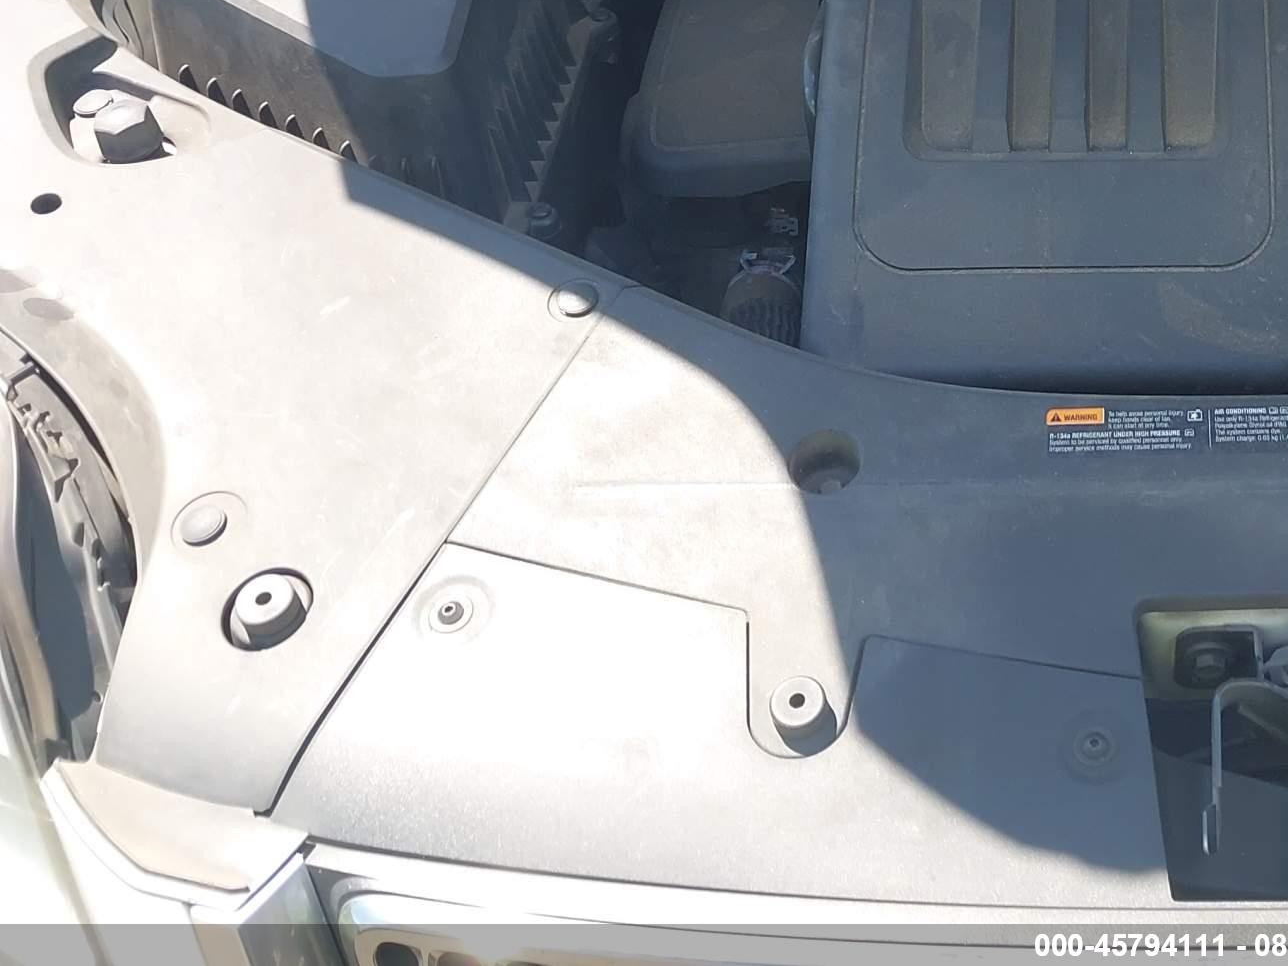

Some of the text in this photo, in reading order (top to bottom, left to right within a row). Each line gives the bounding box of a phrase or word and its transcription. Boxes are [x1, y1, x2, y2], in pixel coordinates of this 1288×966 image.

[1225, 407, 1267, 415] CONDITIONING
[1063, 413, 1098, 421] WARNING
[1049, 432, 1071, 440] R-134a
[1071, 431, 1112, 439] REFRIGERANT
[1113, 430, 1134, 438] UNDER
[1149, 429, 1181, 437] PRESSURE
